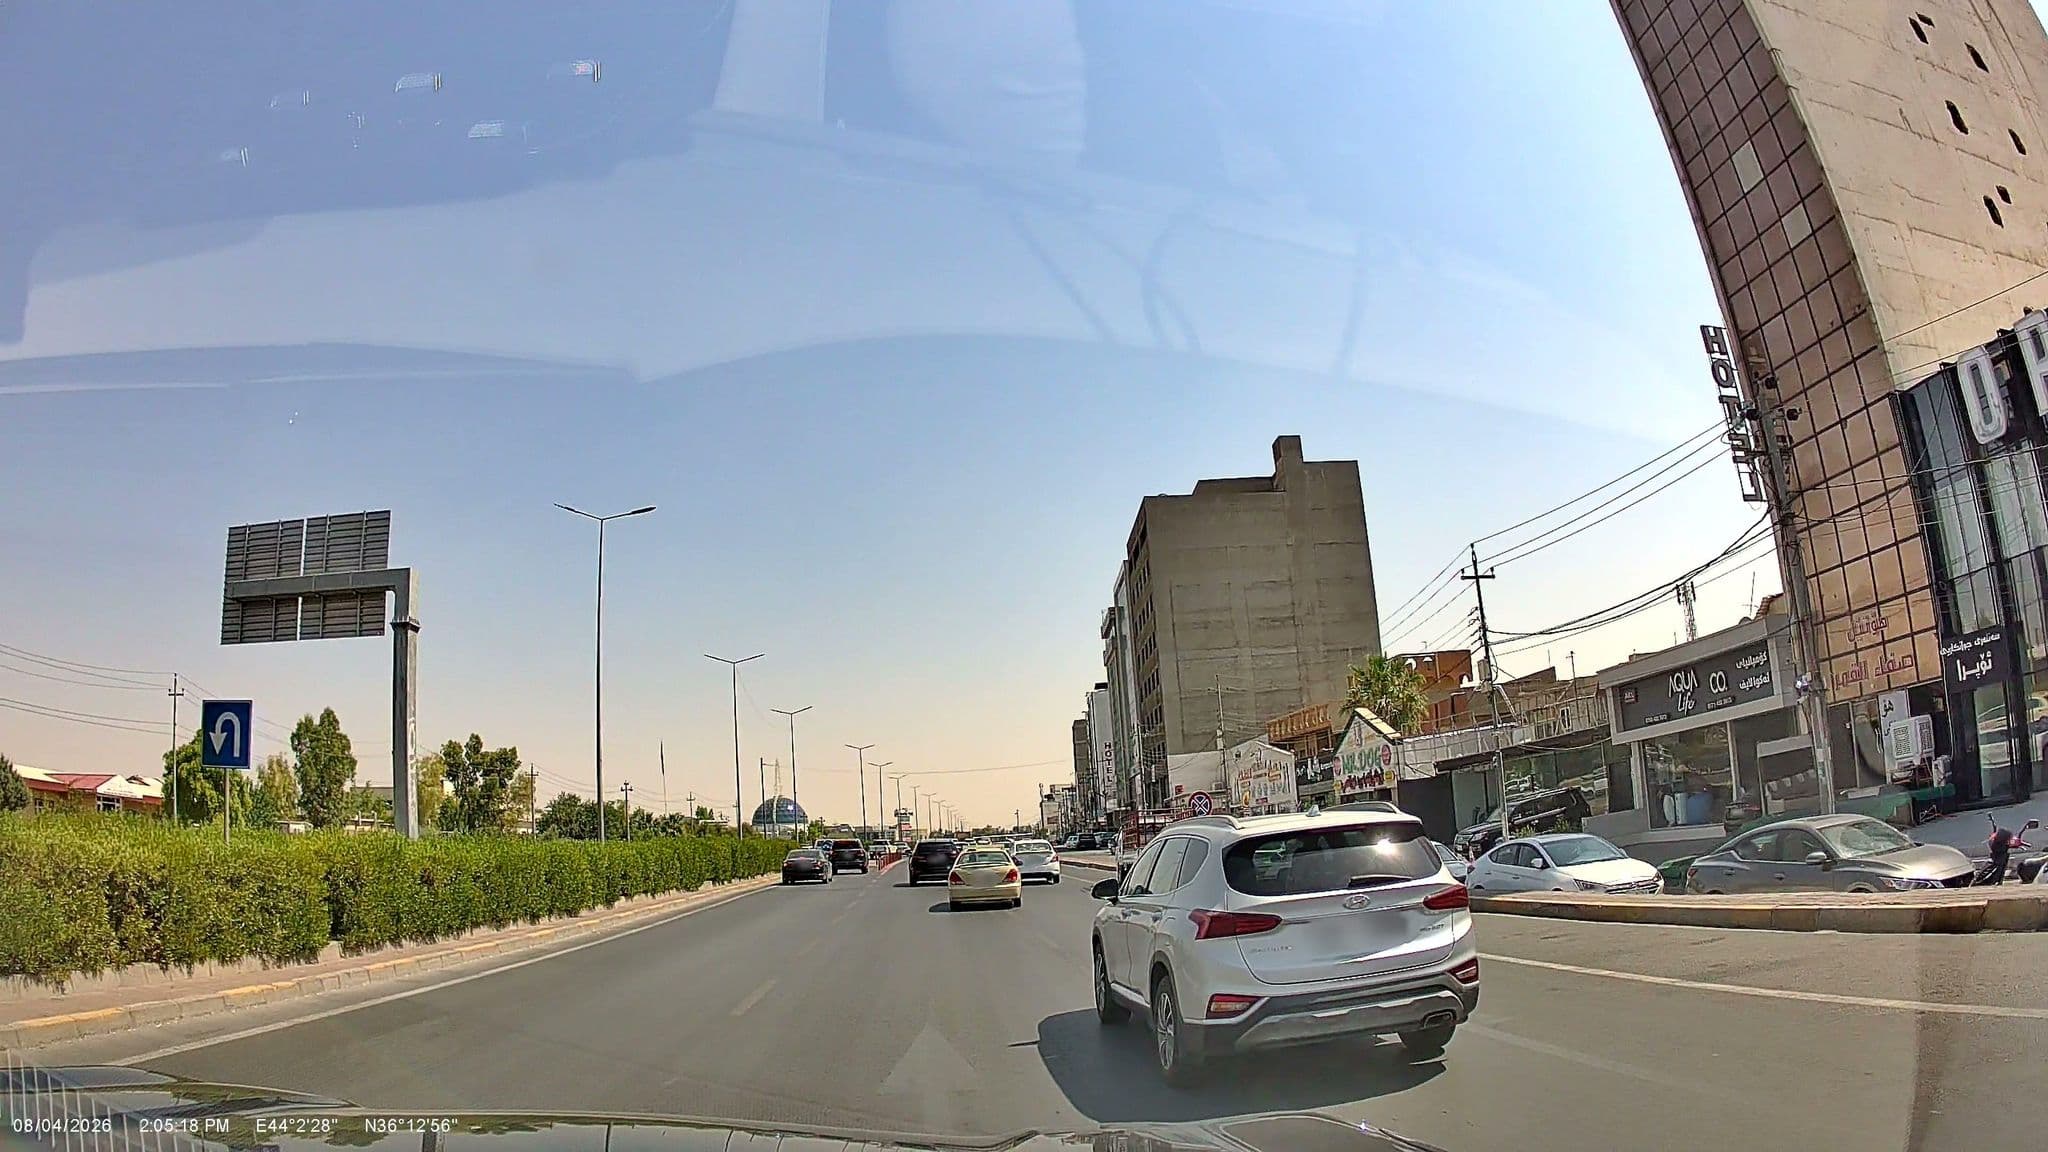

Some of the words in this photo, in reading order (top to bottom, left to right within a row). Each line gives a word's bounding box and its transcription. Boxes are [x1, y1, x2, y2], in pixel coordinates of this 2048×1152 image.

[1710, 671, 1728, 694] CO.
[1677, 692, 1695, 716] Life
[1104, 741, 1113, 783] HOTEL
